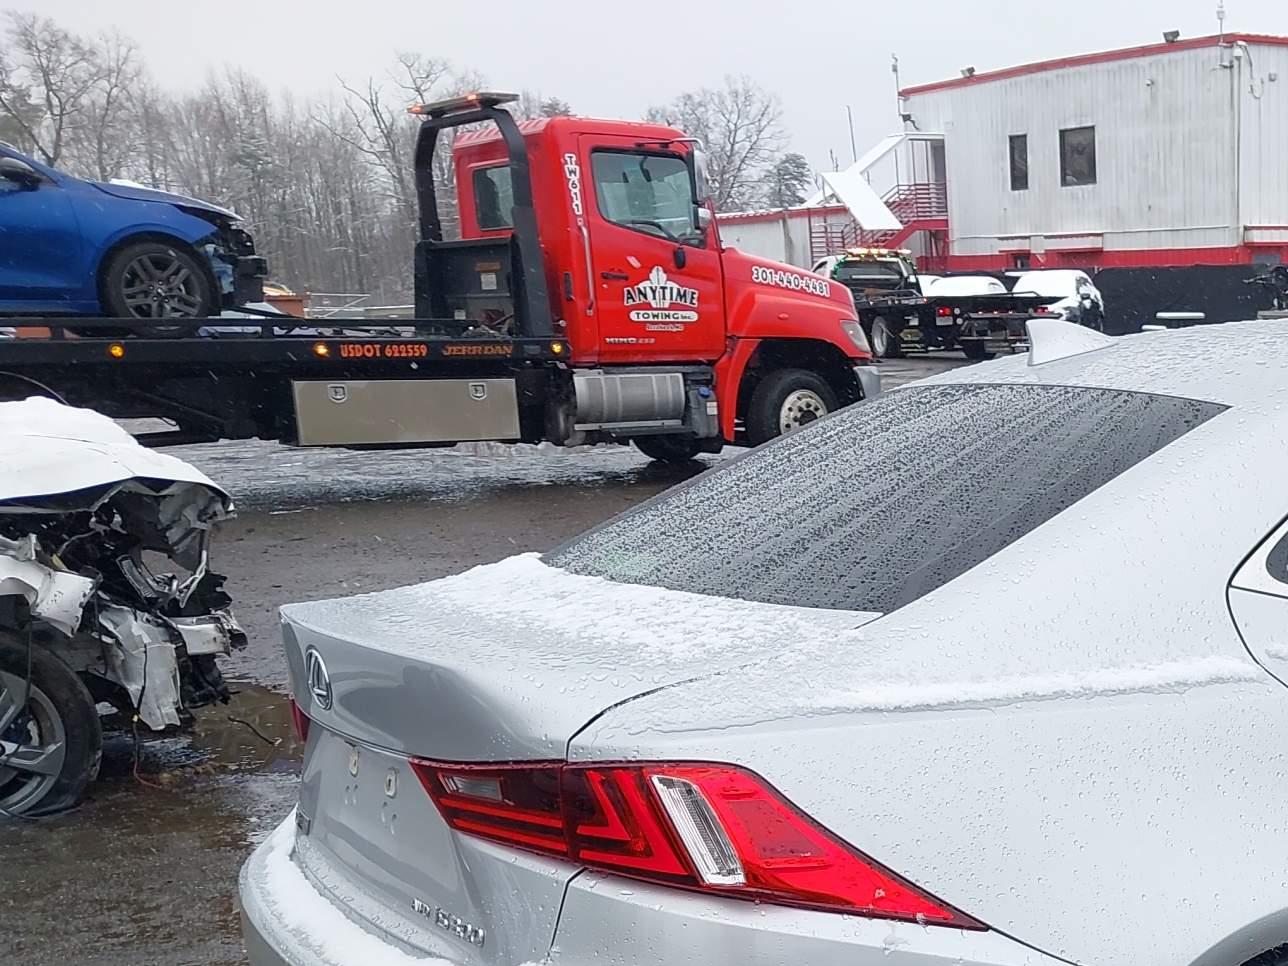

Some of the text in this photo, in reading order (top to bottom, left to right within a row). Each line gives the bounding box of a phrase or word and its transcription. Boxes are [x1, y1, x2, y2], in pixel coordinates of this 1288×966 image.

[564, 154, 582, 214] TW611
[752, 266, 830, 297] 301-440-4481
[624, 285, 698, 306] ANYTIME
[635, 311, 680, 320] TOWING
[340, 344, 428, 357] USDOT 622559
